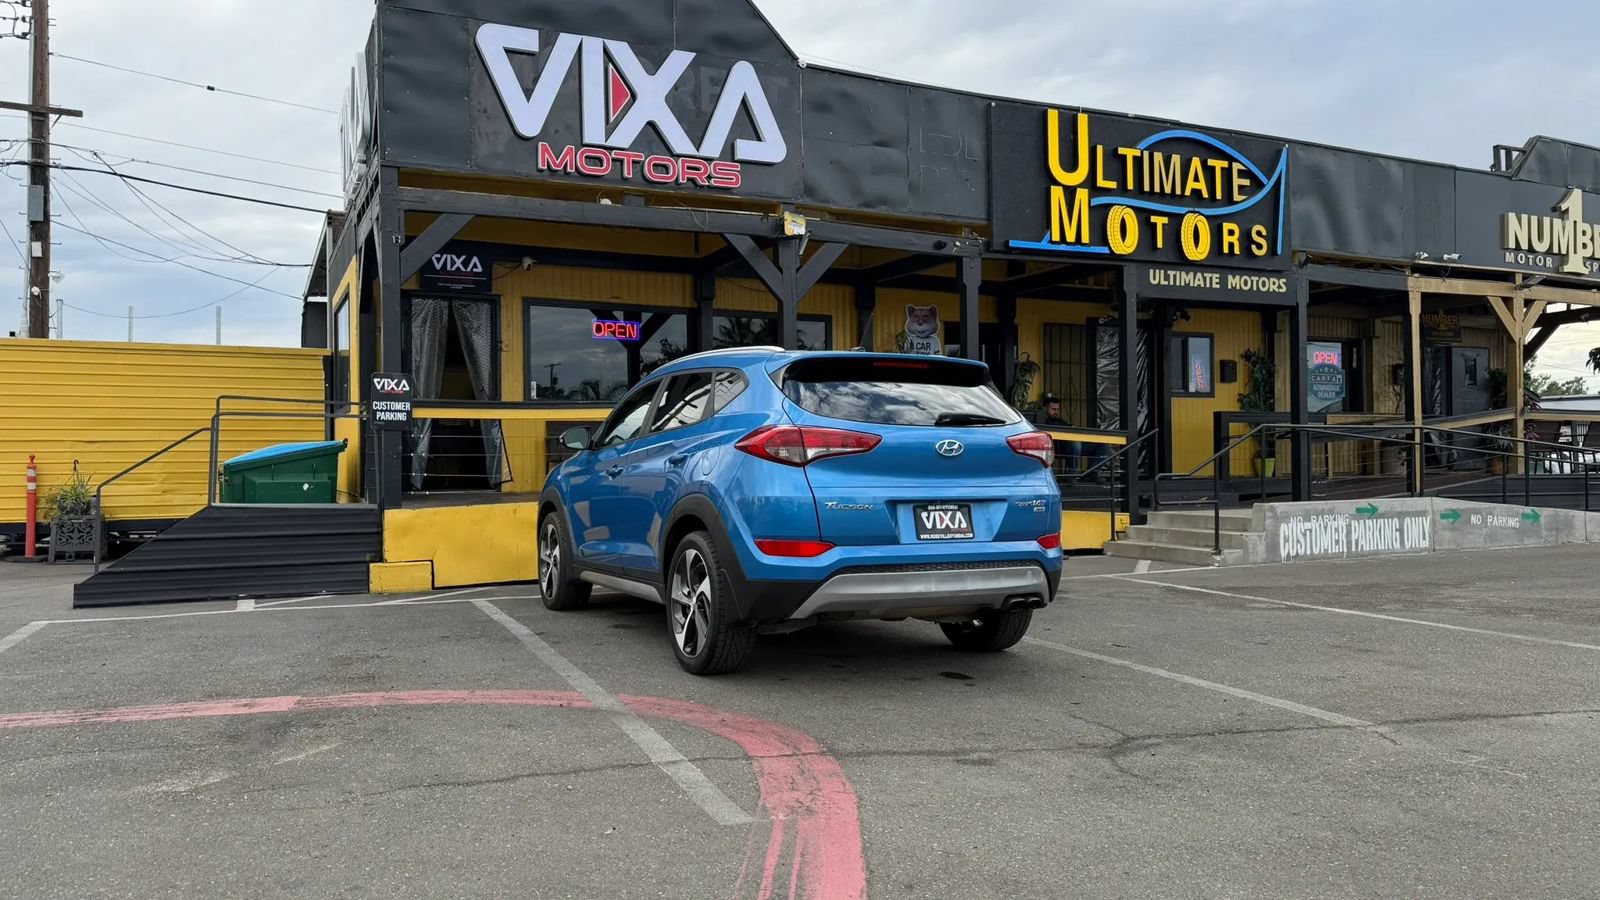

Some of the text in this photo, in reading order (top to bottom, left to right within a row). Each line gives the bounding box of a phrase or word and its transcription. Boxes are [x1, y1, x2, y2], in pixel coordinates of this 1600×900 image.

[475, 23, 787, 165] VIXA
[1046, 107, 1251, 203] ULTIMATE
[537, 141, 742, 189] MOTORS
[1049, 185, 1269, 261] MOTORS
[431, 253, 483, 272] VIXA
[1505, 252, 1553, 268] MOTOR
[1149, 268, 1287, 294] ULTIMATE MOTORS
[592, 322, 638, 338] OPEN
[915, 342, 931, 351] CAR
[1313, 351, 1337, 365] OPEN
[373, 378, 410, 391] VIXA
[372, 401, 411, 411] CUSTOMER
[376, 411, 407, 421] PARKING
[921, 511, 967, 529] VIXA
[1471, 513, 1520, 528] NO PARKING
[1279, 516, 1430, 559] CUSTOMER PARKING ONLY
